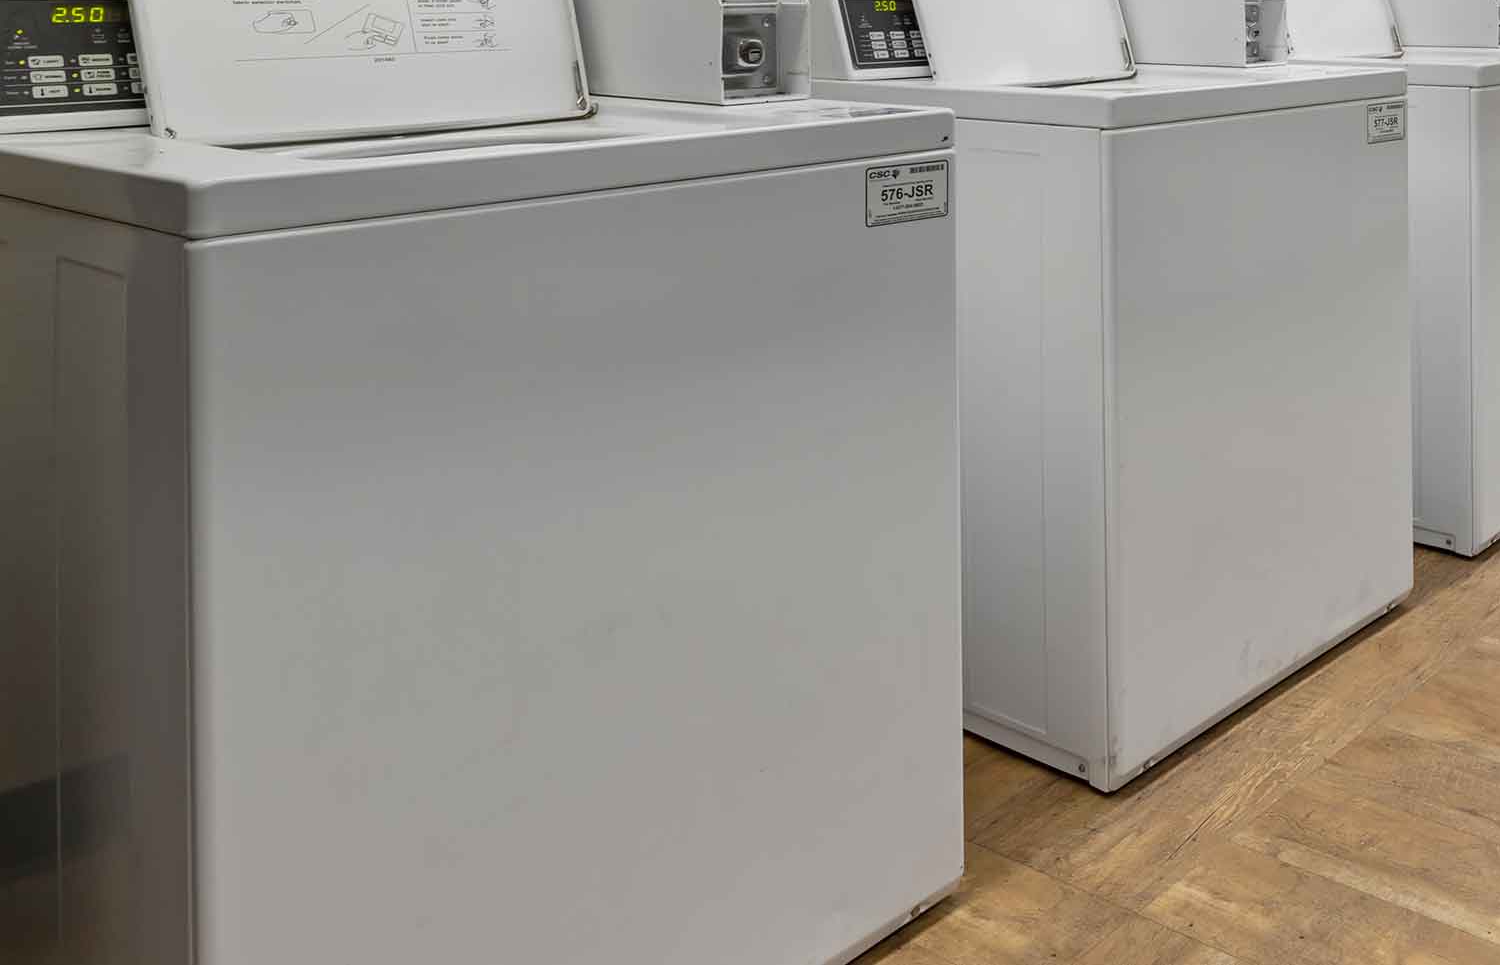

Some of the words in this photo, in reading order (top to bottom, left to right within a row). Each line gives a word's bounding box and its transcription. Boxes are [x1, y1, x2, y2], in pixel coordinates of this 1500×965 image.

[51, 6, 105, 24] 2.50
[869, 170, 891, 180] CSC
[881, 184, 934, 203] 576-JSR
